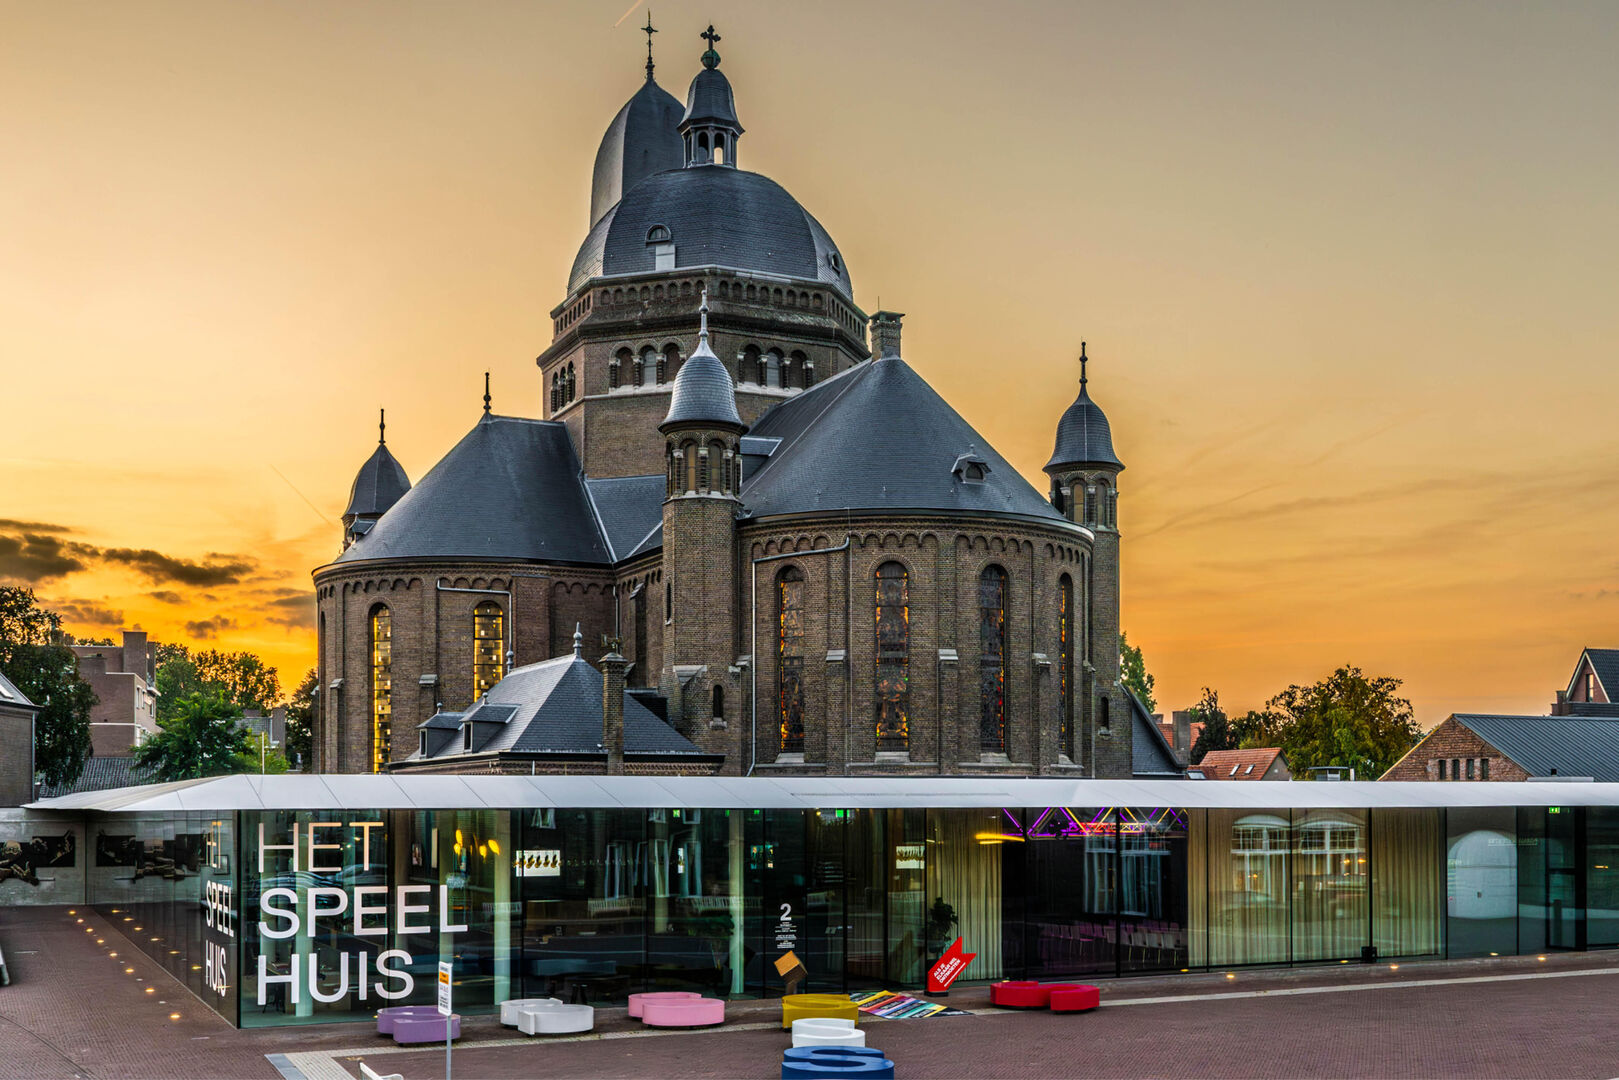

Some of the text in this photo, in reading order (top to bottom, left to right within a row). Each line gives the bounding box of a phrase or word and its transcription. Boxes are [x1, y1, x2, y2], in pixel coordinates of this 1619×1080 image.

[258, 821, 384, 873] HET
[206, 880, 235, 937] SPEEL
[258, 884, 468, 939] SPEEL
[780, 903, 792, 921] 2
[205, 940, 227, 997] HUIS
[257, 949, 415, 1005] HUIS
